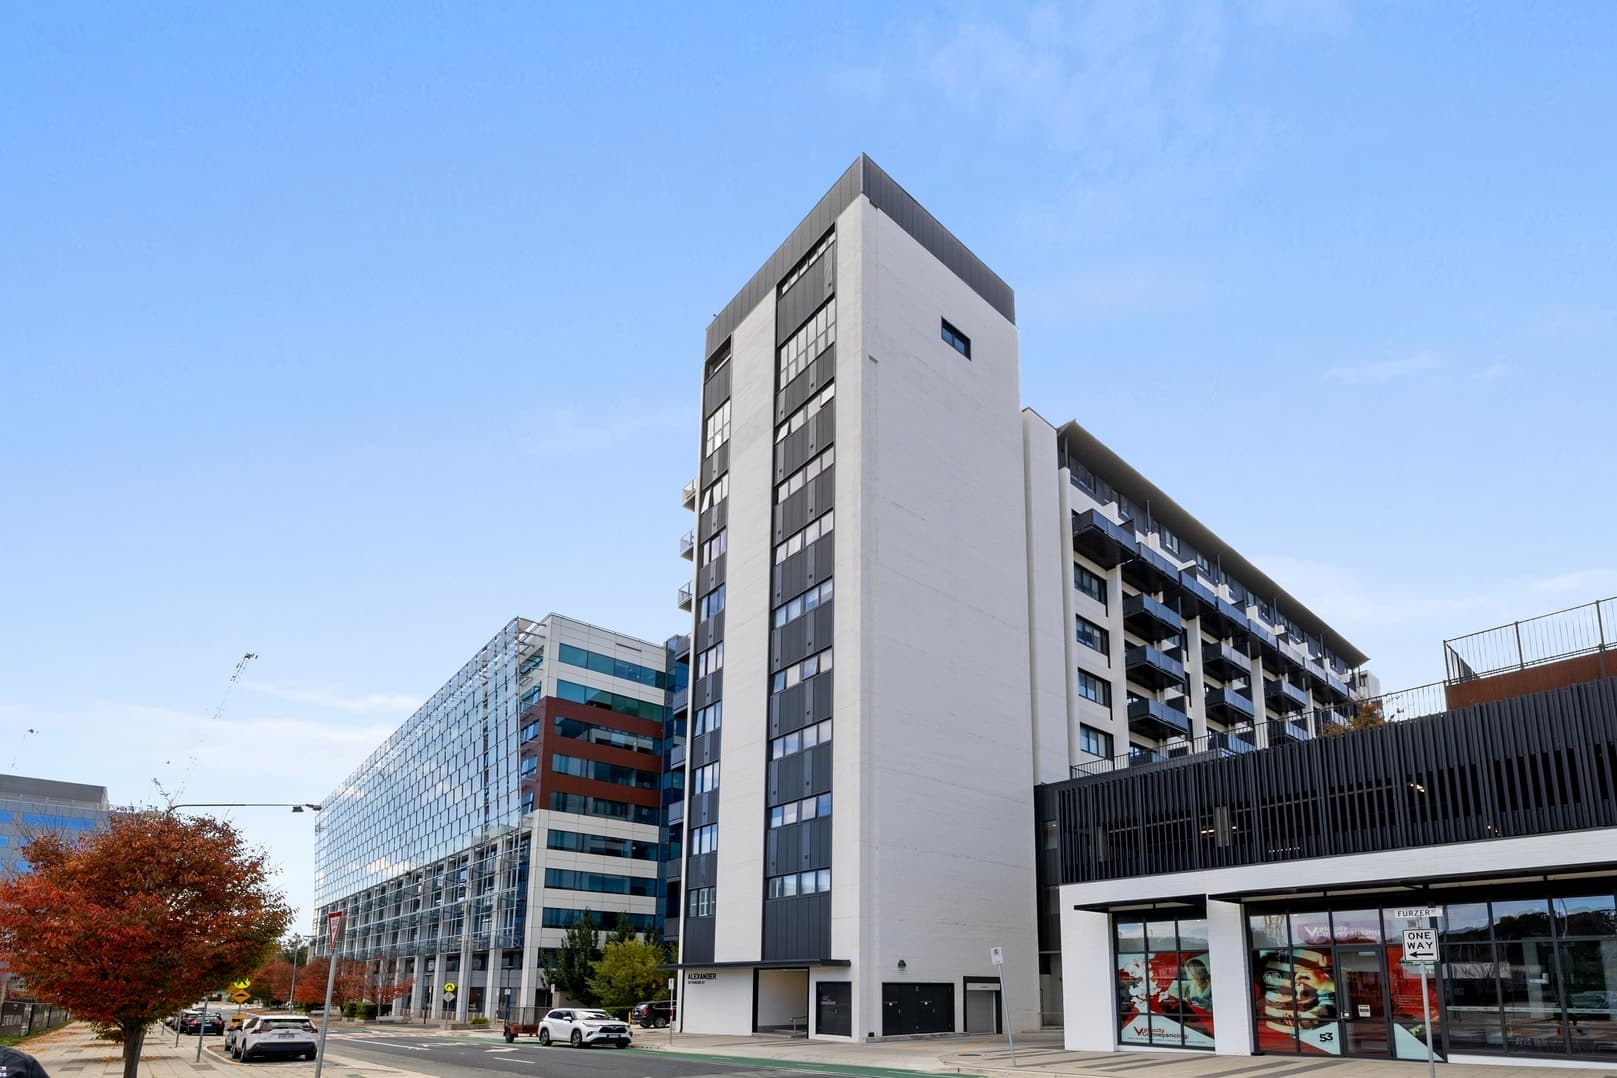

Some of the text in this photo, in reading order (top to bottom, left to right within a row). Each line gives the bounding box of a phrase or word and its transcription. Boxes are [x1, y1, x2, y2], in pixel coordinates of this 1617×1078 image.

[1397, 909, 1430, 917] FURZER
[1408, 932, 1431, 940] ONE
[1407, 942, 1432, 950] WAY
[1319, 1032, 1333, 1042] 53
